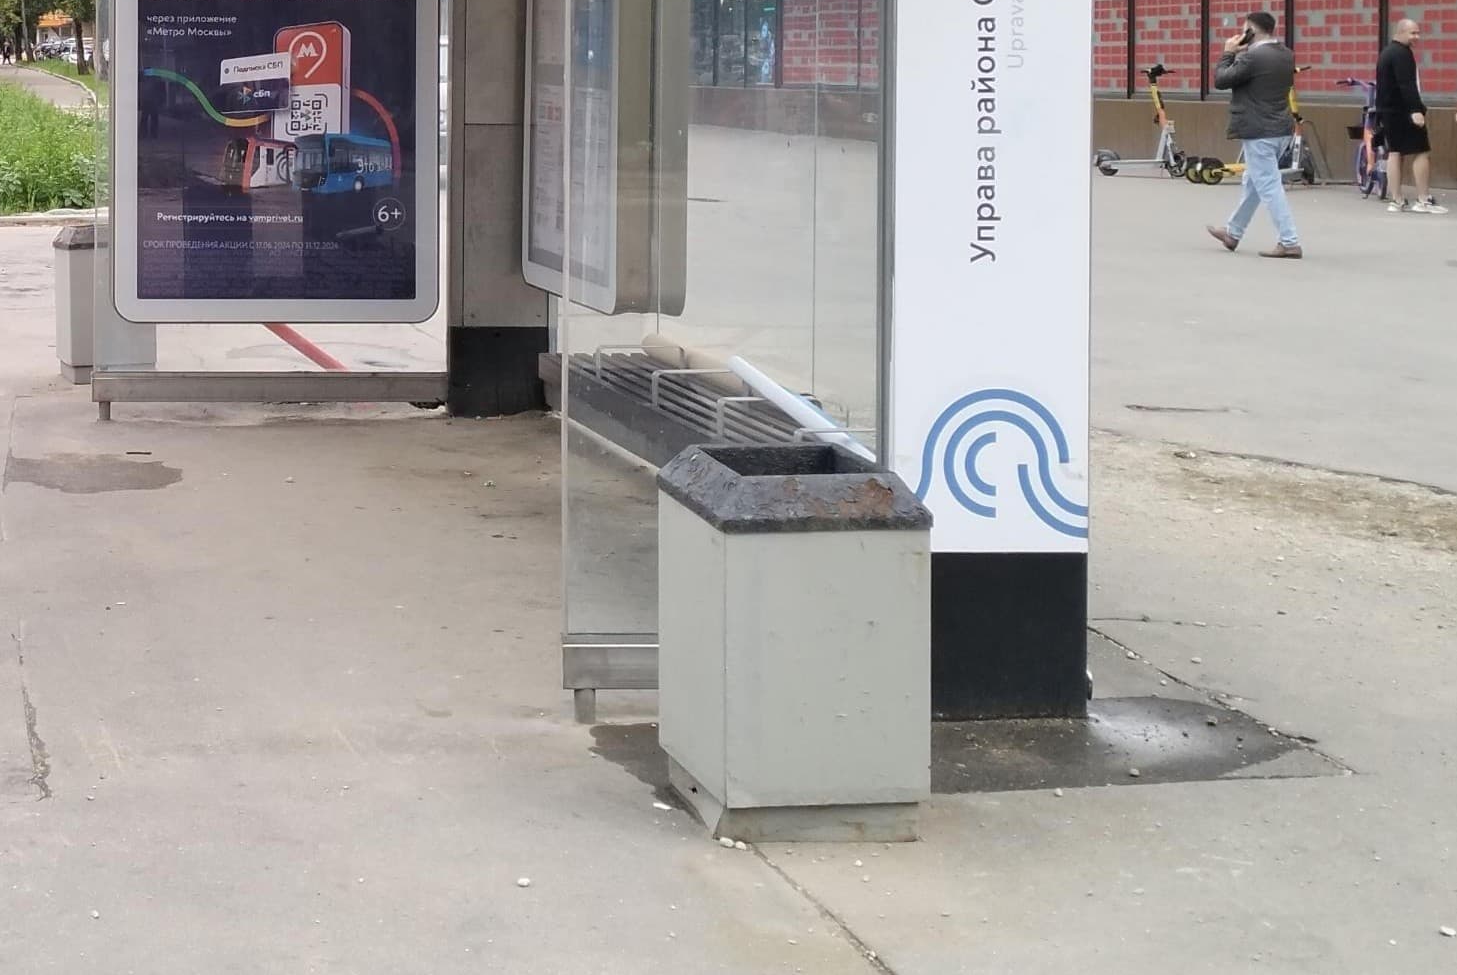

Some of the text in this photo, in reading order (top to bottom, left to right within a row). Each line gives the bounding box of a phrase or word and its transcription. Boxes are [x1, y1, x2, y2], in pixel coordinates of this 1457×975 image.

[146, 15, 237, 24] через приложение
[146, 27, 232, 37] «Метро Москвы»
[970, 15, 1001, 135] района
[253, 89, 271, 98] сбп
[970, 144, 1001, 263] Управа
[156, 212, 235, 224] Регистрируйтесь
[236, 214, 247, 222] на
[377, 207, 402, 222] 6+
